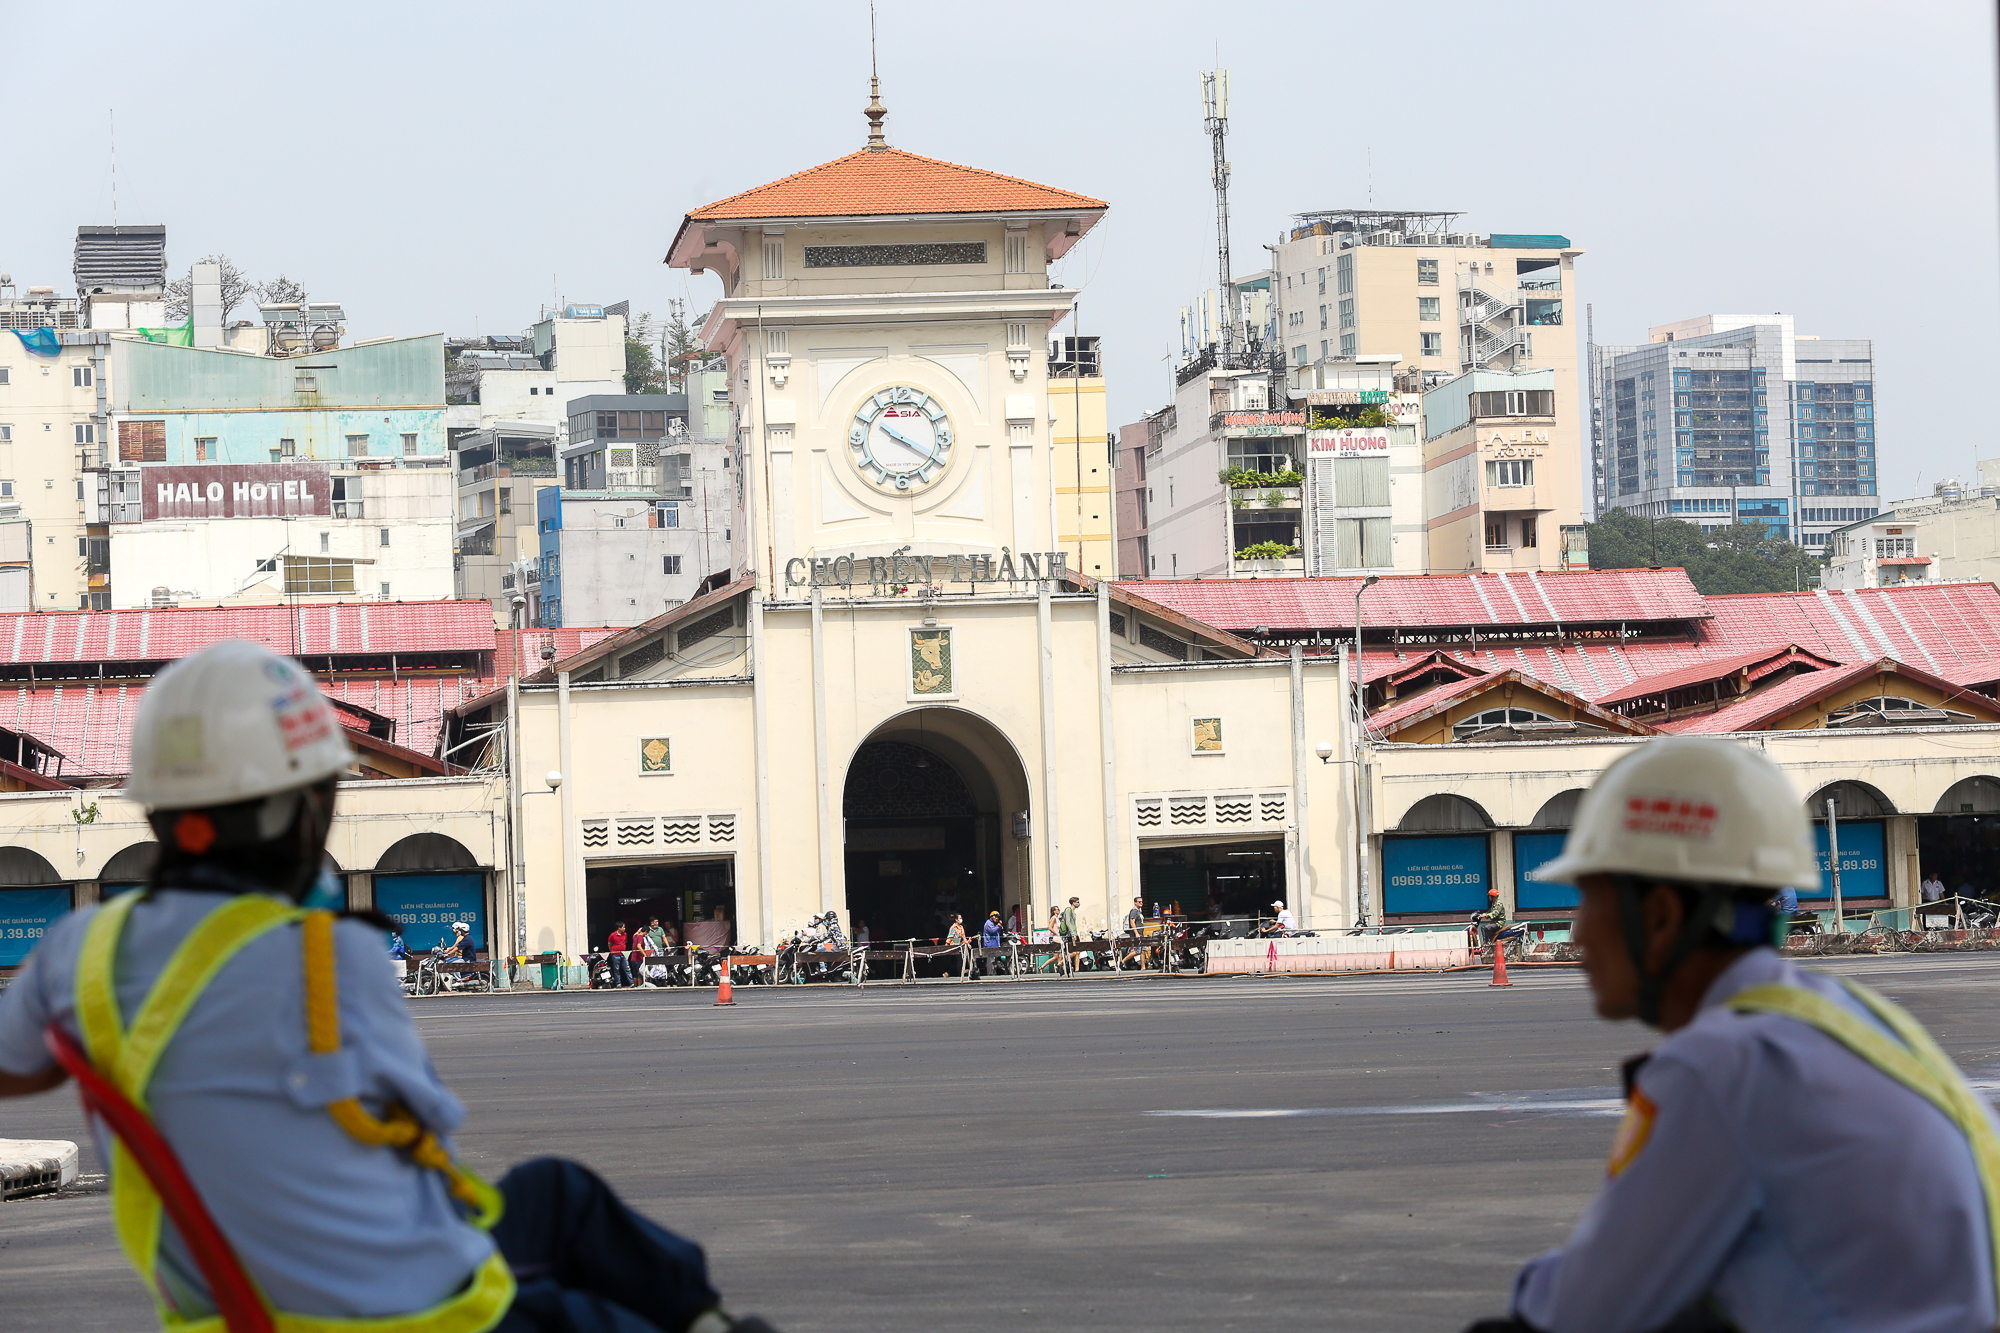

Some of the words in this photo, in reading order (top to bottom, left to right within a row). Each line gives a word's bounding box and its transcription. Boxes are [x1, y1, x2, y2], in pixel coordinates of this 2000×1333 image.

[890, 387, 912, 404] 12
[1360, 391, 1389, 403] HOTEL
[851, 429, 864, 445] 9
[937, 430, 952, 446] 3
[1248, 427, 1284, 435] HOTEL
[1311, 438, 1336, 451] KIM
[1340, 436, 1387, 450] HUONG
[1495, 447, 1543, 458] HOTEL
[896, 473, 909, 489] 6
[157, 482, 225, 503] HALO
[233, 480, 314, 501] HOTEL
[785, 552, 855, 590] CHỢ
[867, 545, 934, 584] BẾN
[948, 546, 1069, 583] THÀNH
[1812, 859, 1877, 871] 9.3.89.89
[1391, 873, 1480, 886] 0969.39.89.89
